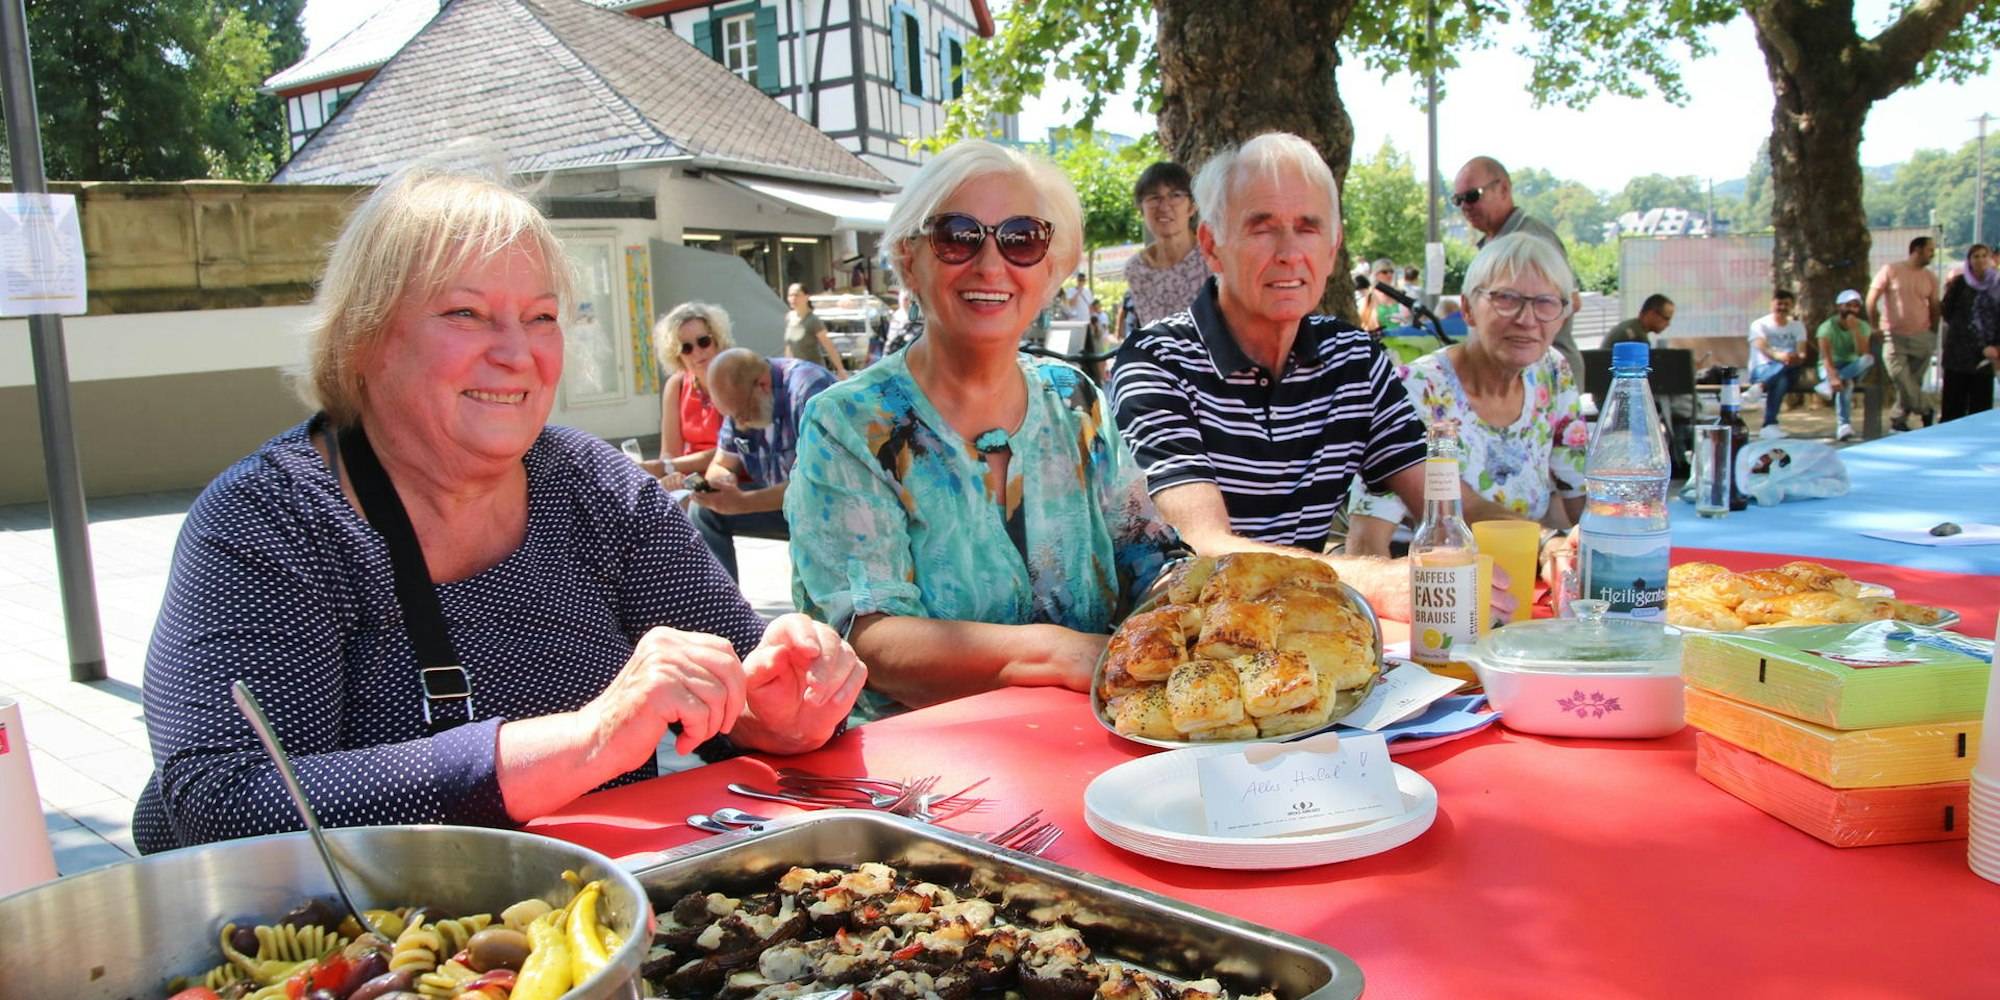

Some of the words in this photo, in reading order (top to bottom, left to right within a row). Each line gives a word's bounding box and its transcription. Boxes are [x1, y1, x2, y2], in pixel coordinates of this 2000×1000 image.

[1414, 570, 1455, 584] GAFFELS
[1415, 586, 1456, 608] FASS
[1415, 610, 1456, 624] BRAUSE
[1241, 780, 1280, 802] Alles
